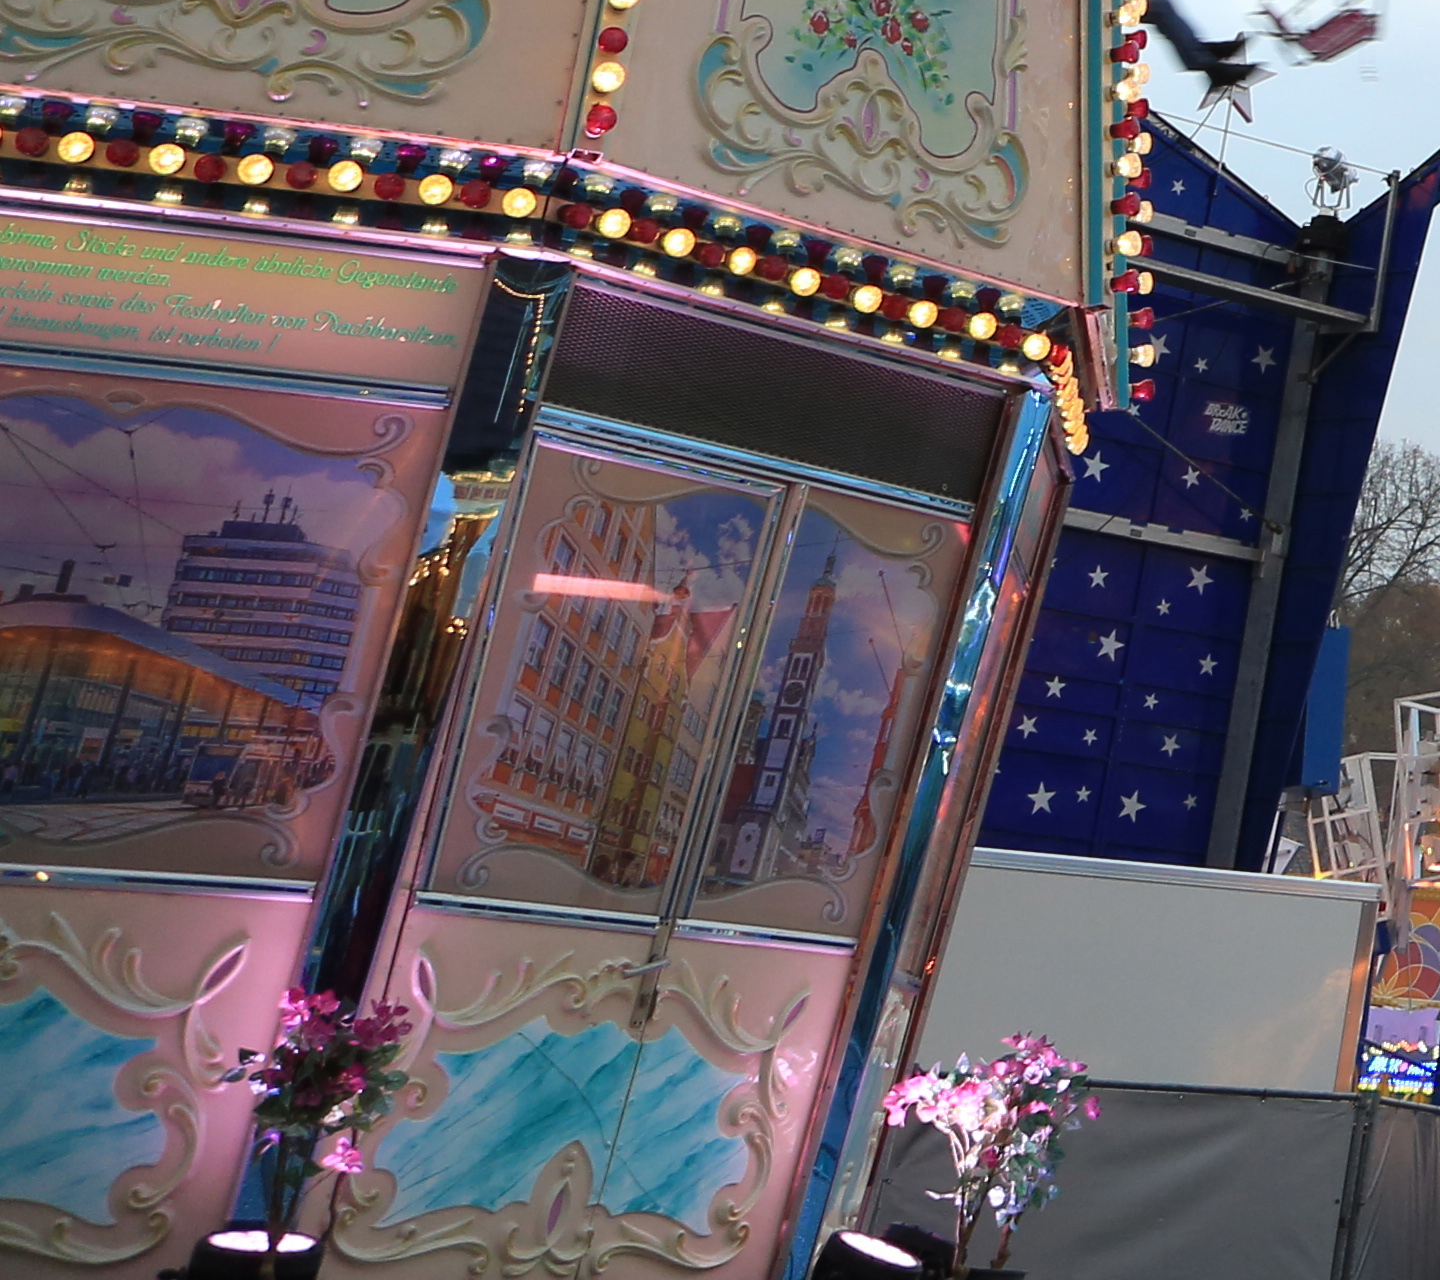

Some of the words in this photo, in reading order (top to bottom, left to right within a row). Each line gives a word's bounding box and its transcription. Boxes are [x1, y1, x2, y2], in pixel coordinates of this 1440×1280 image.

[0, 223, 57, 250] hirme,
[65, 229, 137, 258] Stöcke
[141, 241, 184, 262] und
[180, 246, 250, 269] andere
[97, 264, 171, 287] werden.
[58, 291, 117, 309] sowie
[119, 291, 158, 313] das
[271, 315, 308, 330] von
[178, 328, 262, 352] verboten
